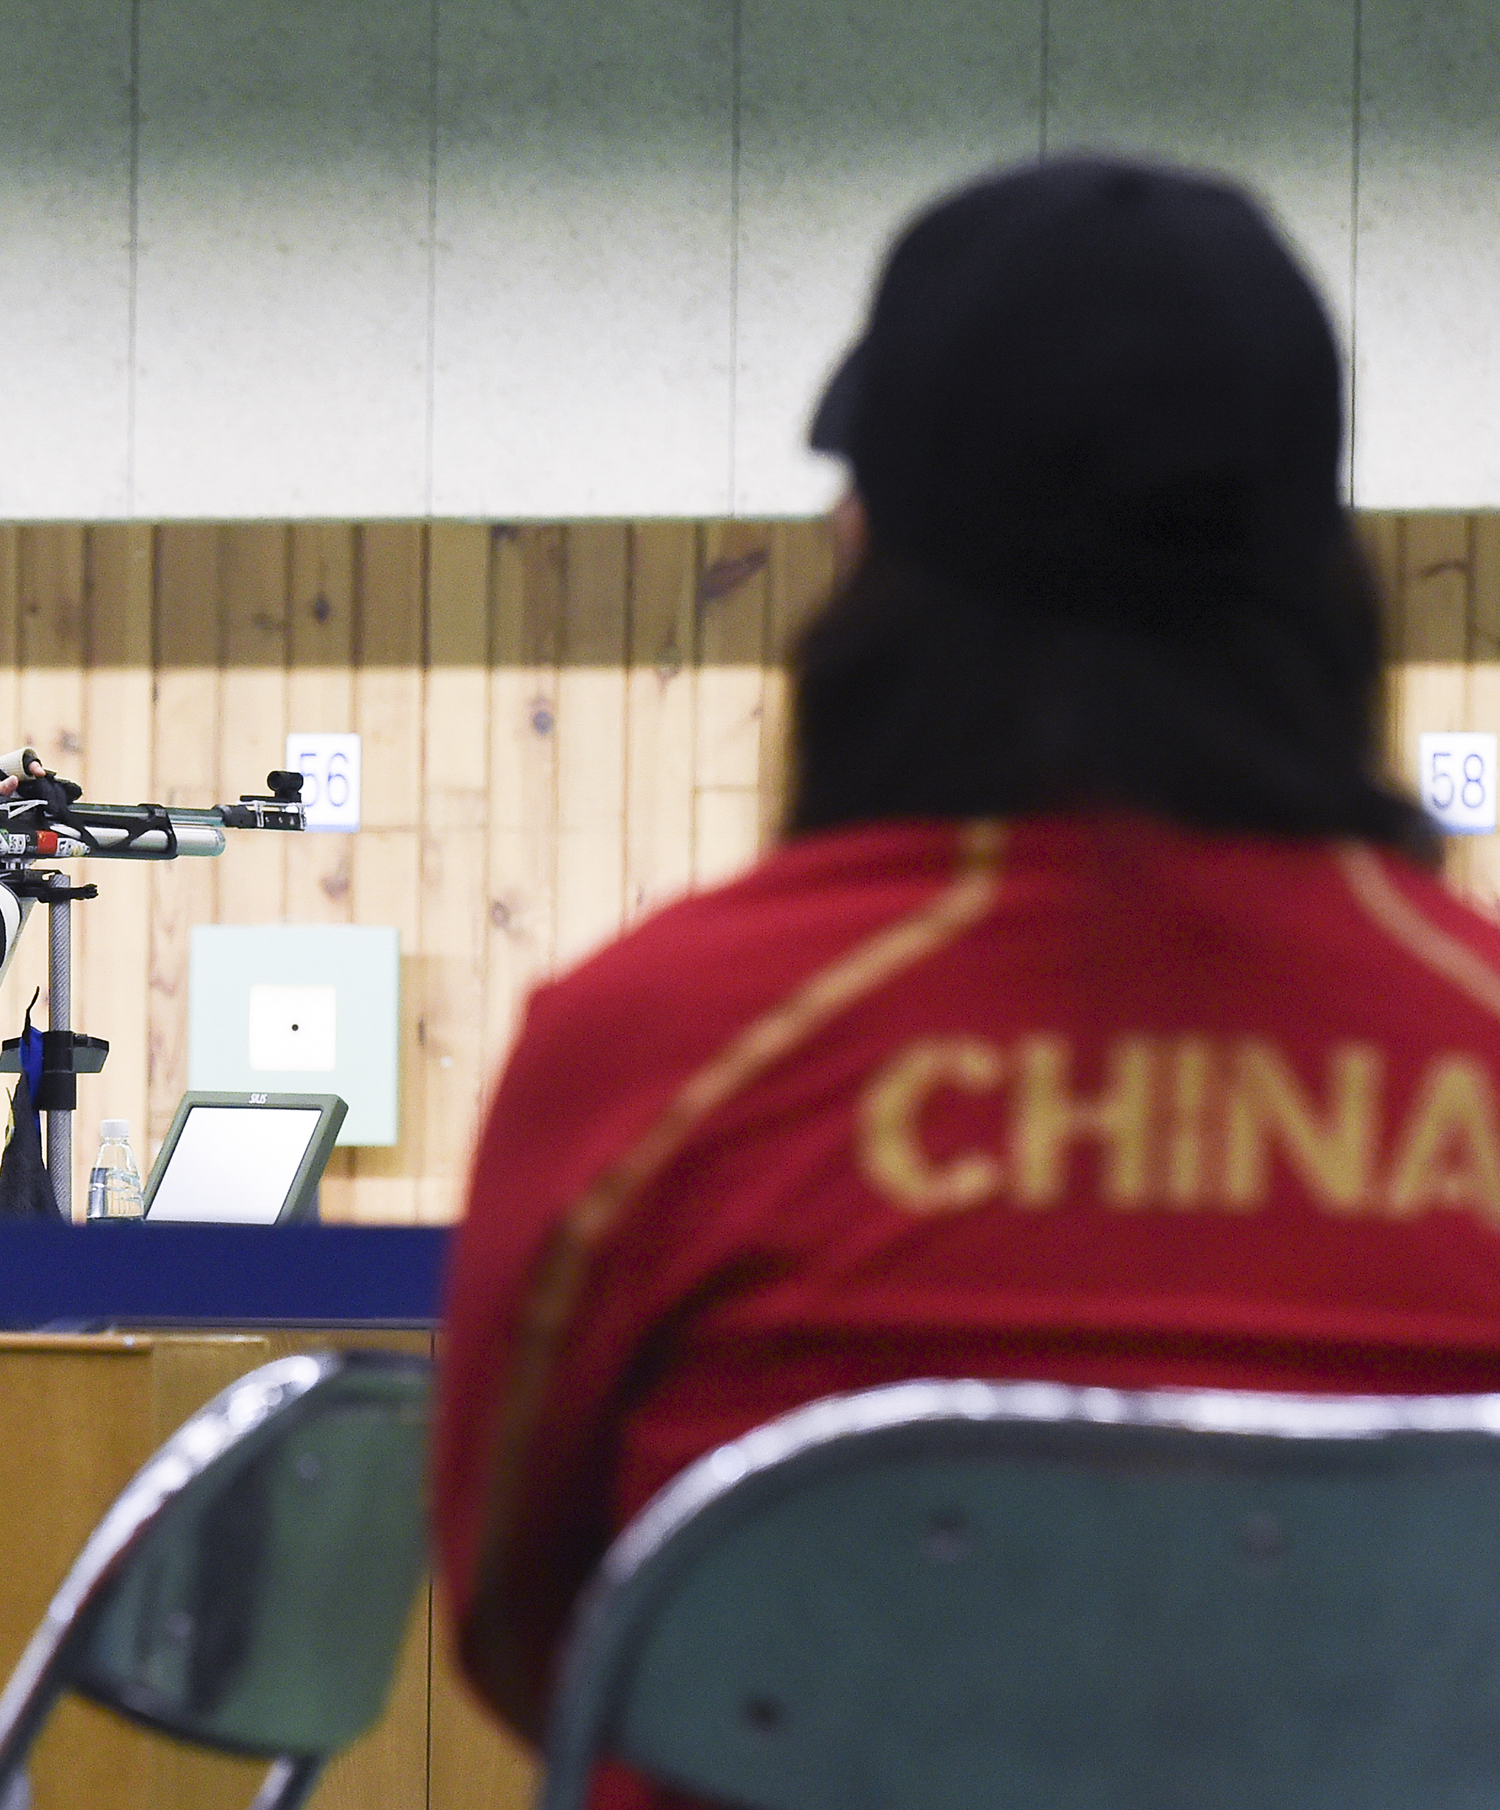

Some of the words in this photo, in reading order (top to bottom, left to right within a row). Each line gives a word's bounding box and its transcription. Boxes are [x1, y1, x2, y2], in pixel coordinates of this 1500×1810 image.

[299, 752, 349, 807] 56
[1431, 752, 1485, 809] 58
[856, 1034, 1500, 1233] CHINA
